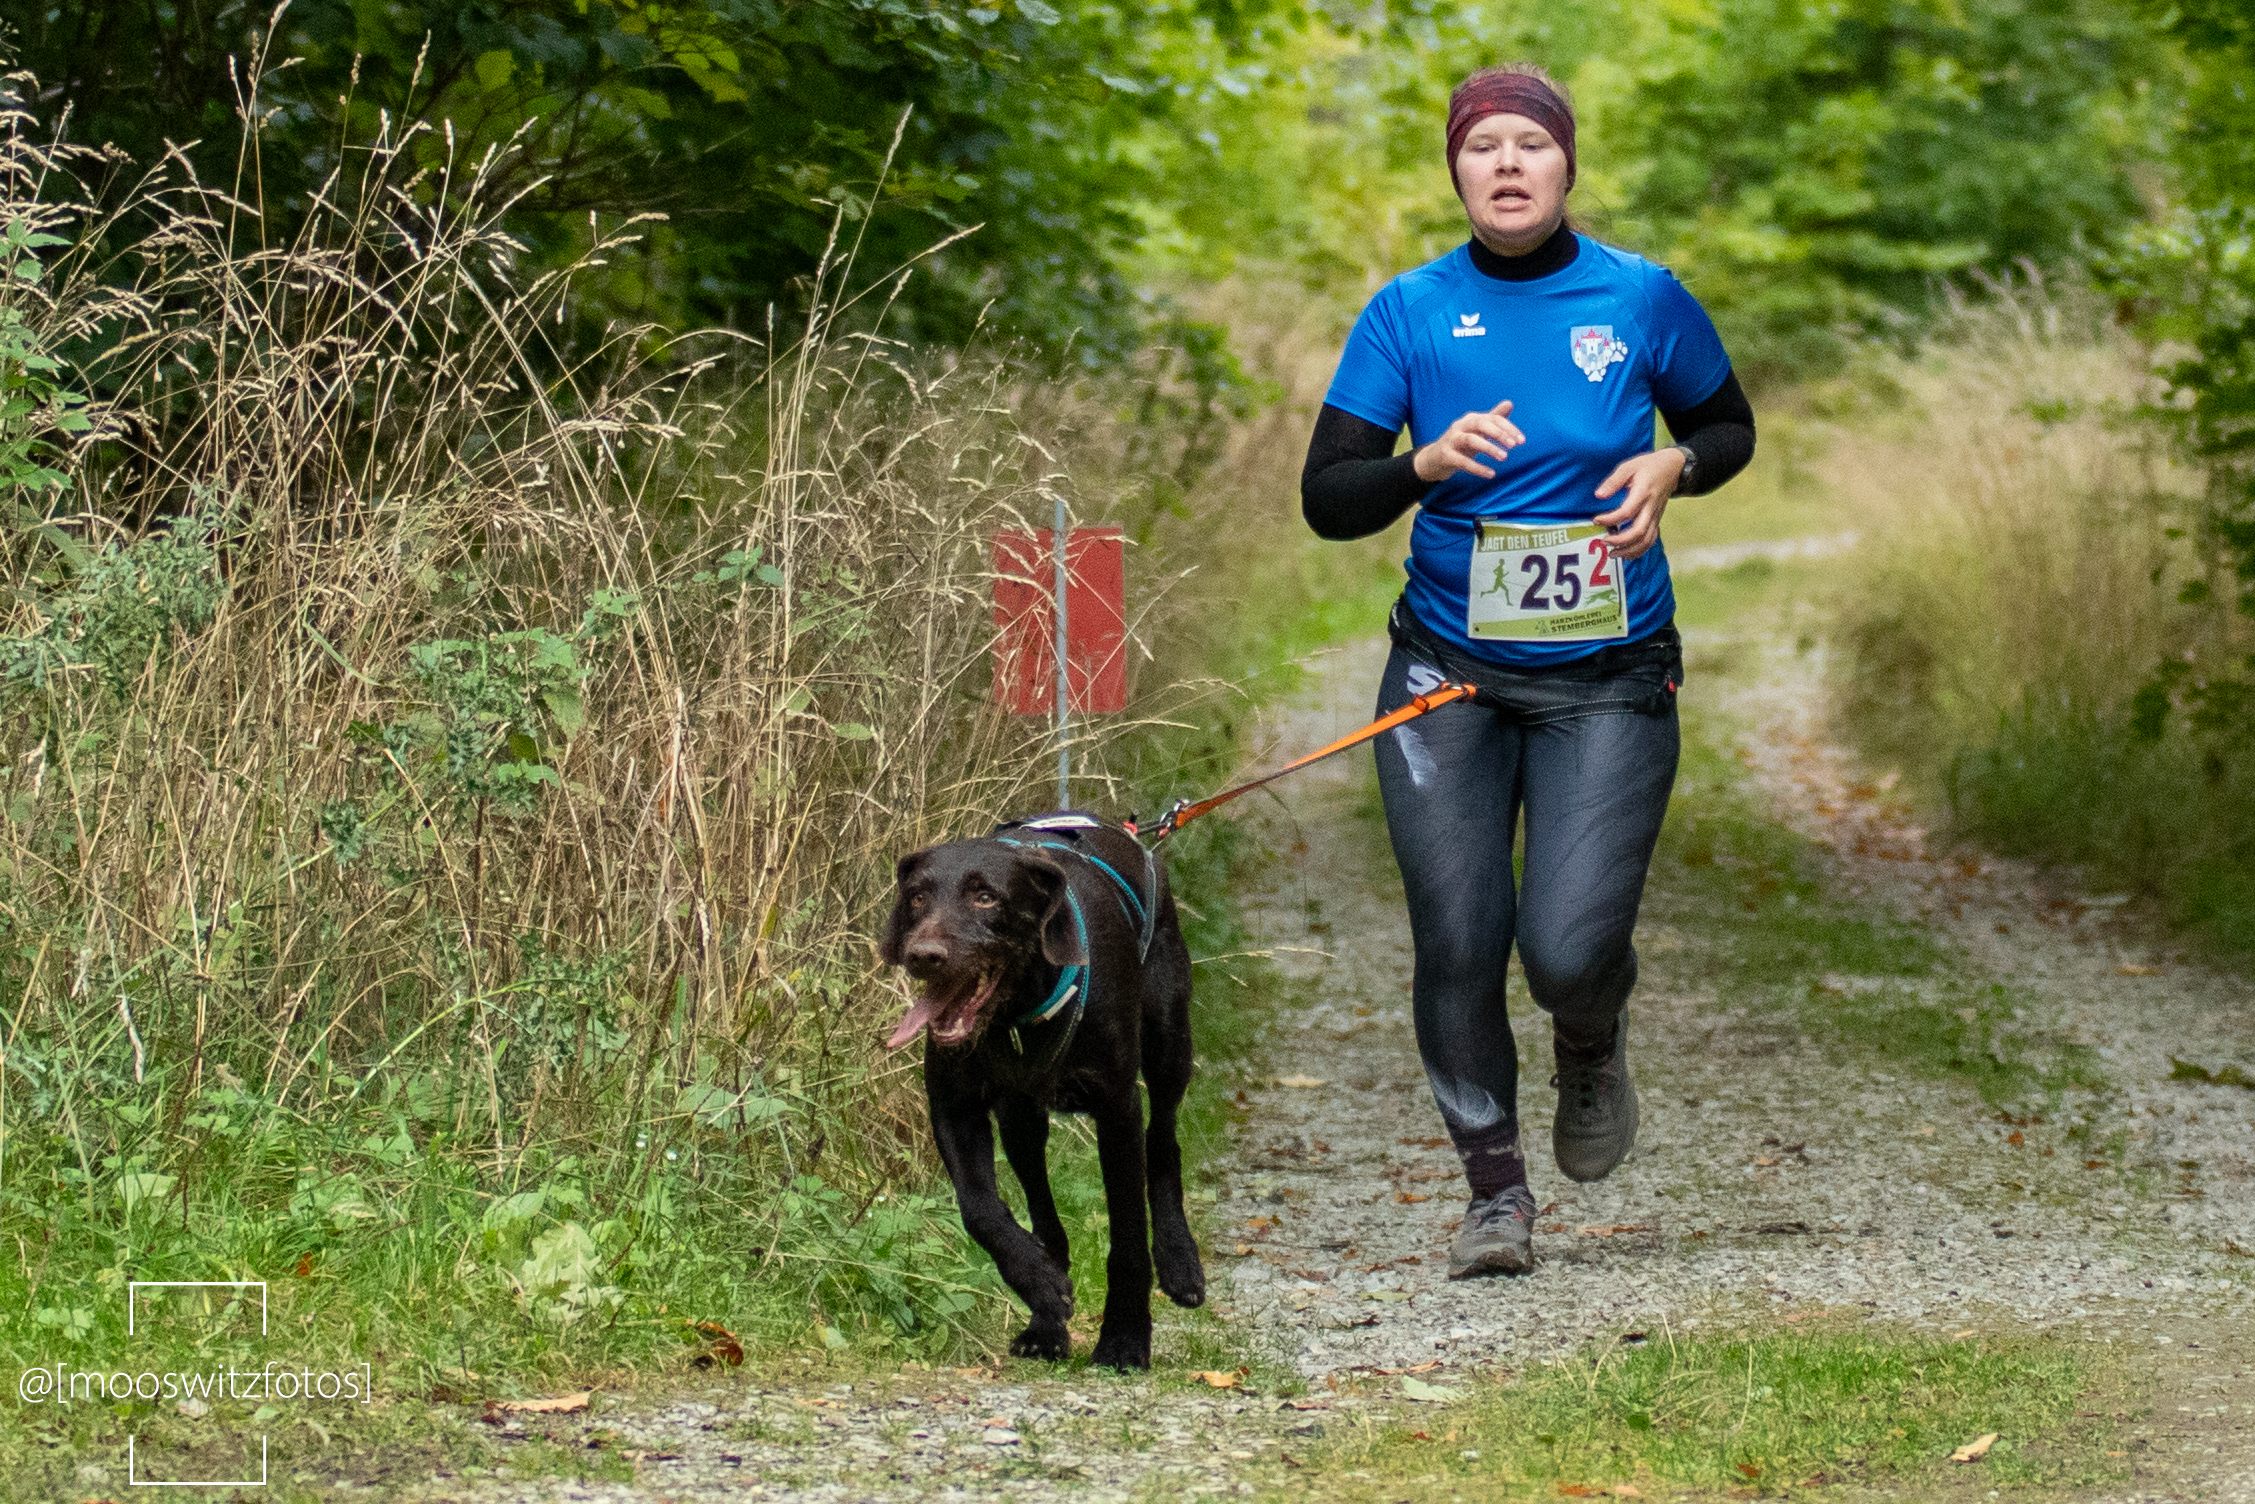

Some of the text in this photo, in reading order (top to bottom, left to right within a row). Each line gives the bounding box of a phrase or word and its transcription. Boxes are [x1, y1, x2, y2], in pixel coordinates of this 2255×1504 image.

[1481, 528, 1570, 552] JAGT DEN TEUFEL
